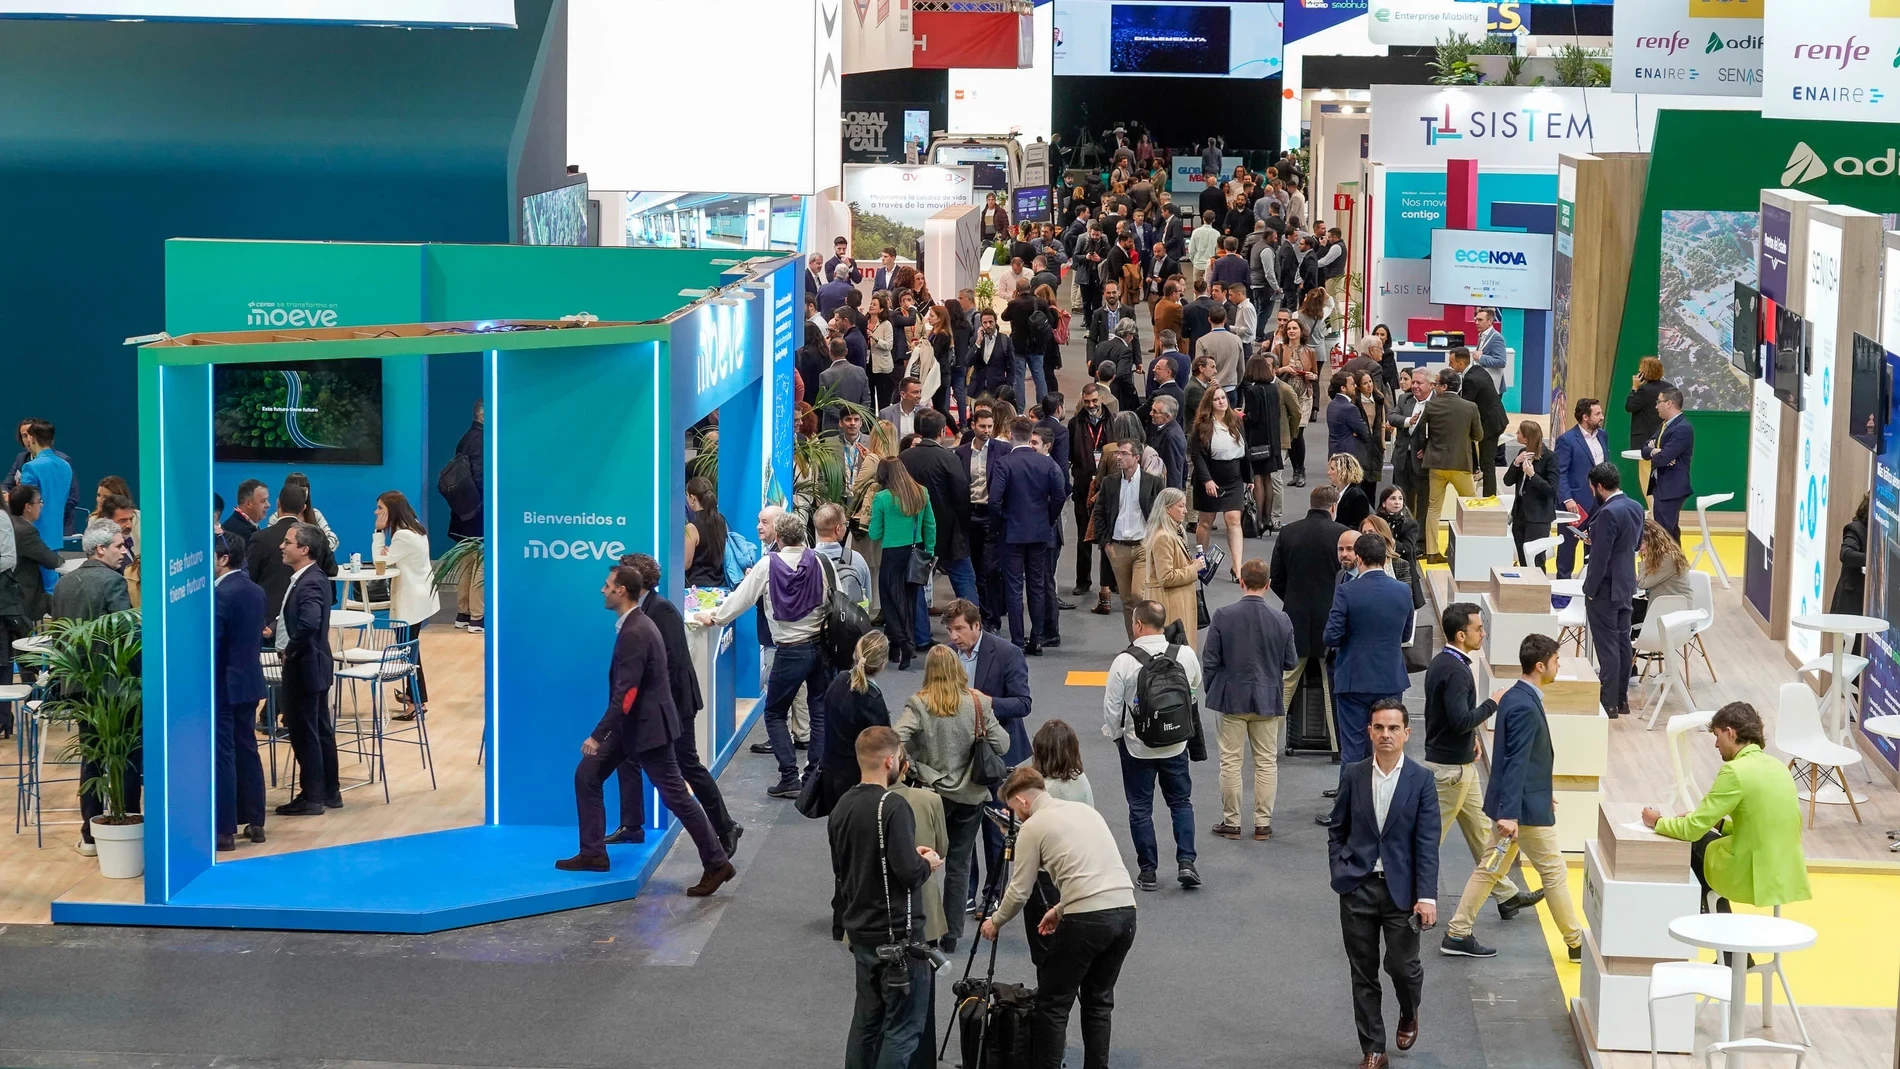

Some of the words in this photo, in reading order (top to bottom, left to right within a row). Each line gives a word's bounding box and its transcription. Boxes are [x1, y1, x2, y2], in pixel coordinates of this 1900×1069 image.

[1394, 11, 1440, 21] Enterprise
[1442, 12, 1479, 22] Mobility
[1636, 30, 1690, 56] renfe
[1726, 35, 1764, 50] adif
[1794, 35, 1870, 70] renfe
[1469, 108, 1594, 142] SISTEM
[849, 137, 887, 151] CALL
[1177, 166, 1203, 175] GLOB
[878, 201, 903, 209] través
[904, 201, 915, 209] de
[917, 201, 925, 209] la
[1401, 197, 1421, 207] Nos
[1401, 209, 1440, 221] contigo
[1454, 248, 1528, 266] eceNOVA
[286, 301, 328, 309] transforma
[247, 308, 338, 327] moeve
[697, 309, 745, 396] moeve
[523, 511, 613, 526] Bienvenidos
[616, 516, 627, 526] a
[523, 539, 626, 560] moeve
[169, 557, 183, 577] Este
[183, 550, 204, 570] futuro
[169, 584, 186, 604] tiene
[186, 575, 206, 596] futuro
